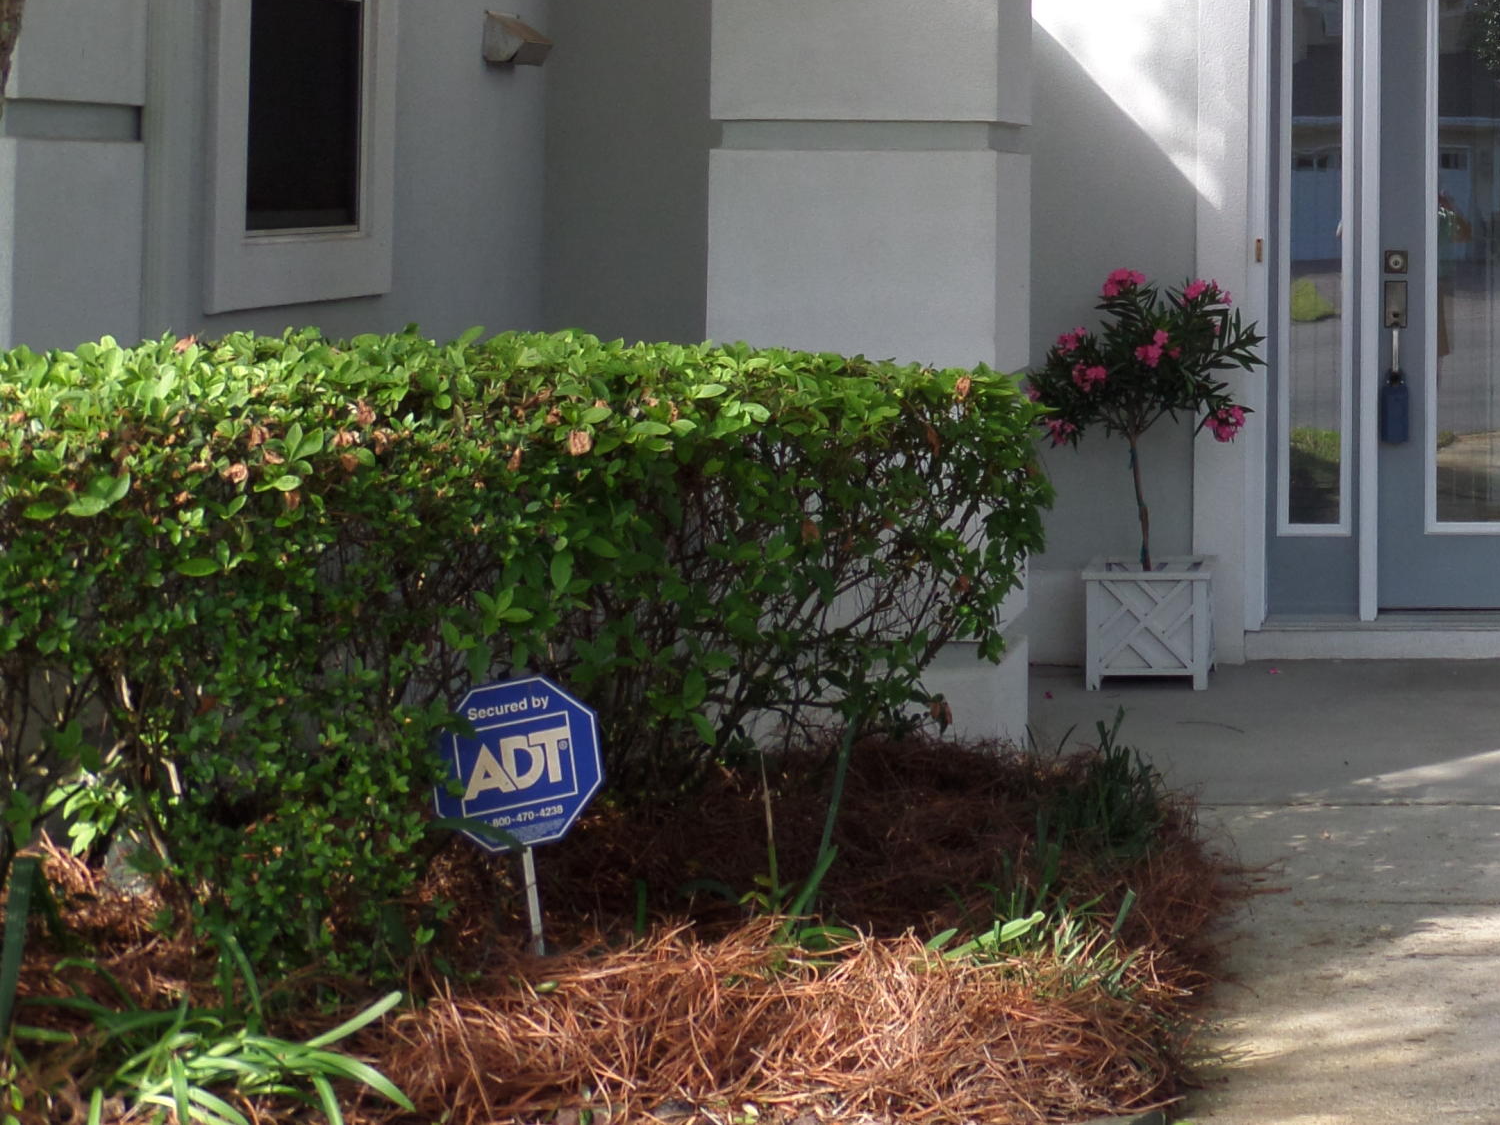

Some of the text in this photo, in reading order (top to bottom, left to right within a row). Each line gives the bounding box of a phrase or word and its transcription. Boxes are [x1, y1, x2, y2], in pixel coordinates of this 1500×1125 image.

[467, 695, 549, 720] Secured by
[464, 727, 570, 801] ADT
[484, 805, 564, 828] -800-470-4238
